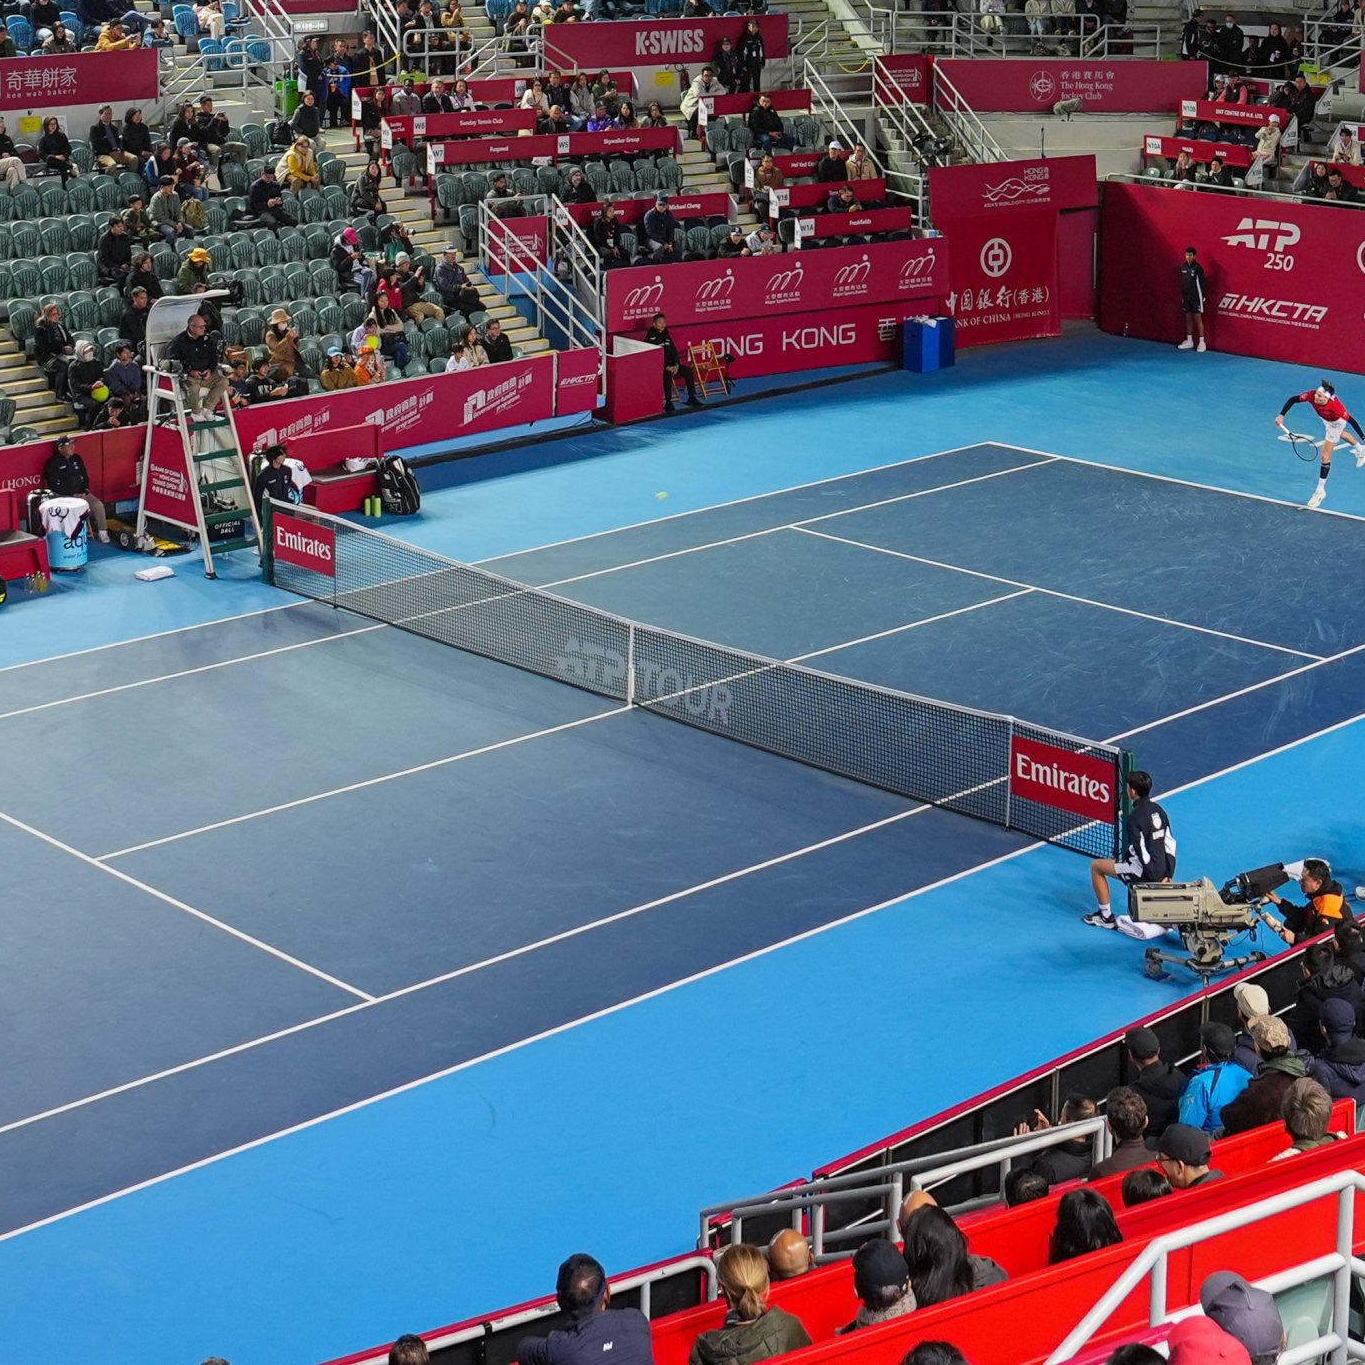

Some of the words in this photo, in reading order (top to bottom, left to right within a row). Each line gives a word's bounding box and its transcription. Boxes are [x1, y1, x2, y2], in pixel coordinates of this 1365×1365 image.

[6, 66, 78, 91] 奇華餅家
[1060, 81, 1071, 90] The
[1073, 82, 1090, 92] Hong
[1092, 82, 1114, 92] Kong
[26, 90, 43, 98] wah
[46, 88, 78, 97] bakery
[1061, 91, 1086, 102] Jockey
[1087, 91, 1103, 100] Club
[1220, 217, 1301, 252] ATP
[1264, 253, 1294, 272] 250
[982, 314, 1011, 325] CHINA
[1238, 295, 1329, 324] HKCTA
[782, 323, 857, 352] KONG
[214, 520, 241, 530] OFFICIAL
[220, 527, 235, 535] BALL
[276, 525, 332, 561] Emirates
[637, 660, 733, 725] TOUR
[1015, 750, 1112, 805] Emirates
